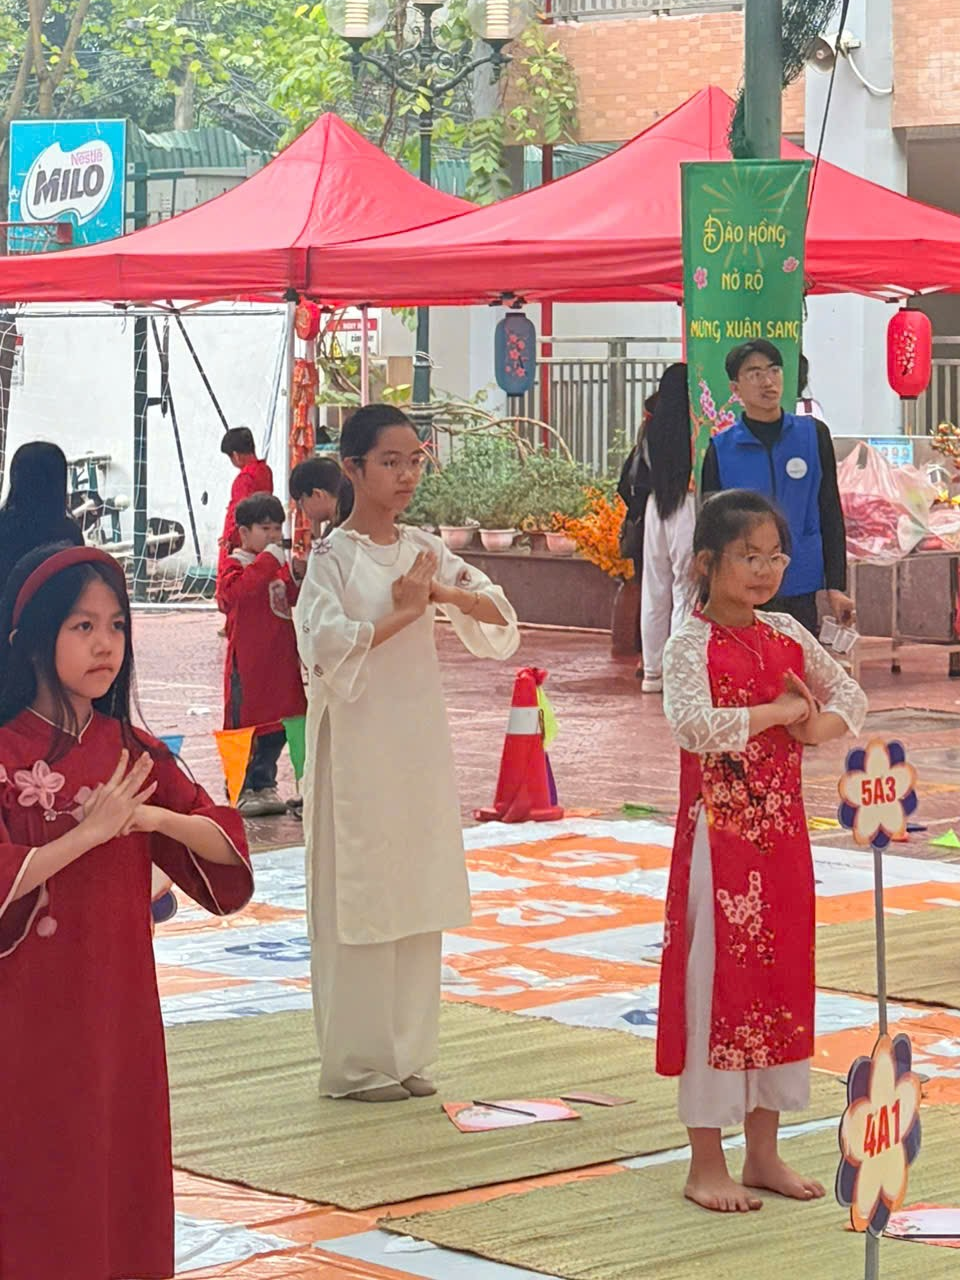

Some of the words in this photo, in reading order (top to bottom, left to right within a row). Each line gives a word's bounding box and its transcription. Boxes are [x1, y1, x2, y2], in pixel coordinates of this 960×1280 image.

[33, 164, 104, 206] MILO
[748, 218, 787, 249] HỒNG
[721, 266, 740, 290] NỞ
[744, 270, 764, 295] RỘ
[726, 316, 761, 338] XUÂN
[767, 320, 800, 343] SANG
[861, 776, 896, 806] 5A3
[863, 1099, 902, 1158] 4A1
